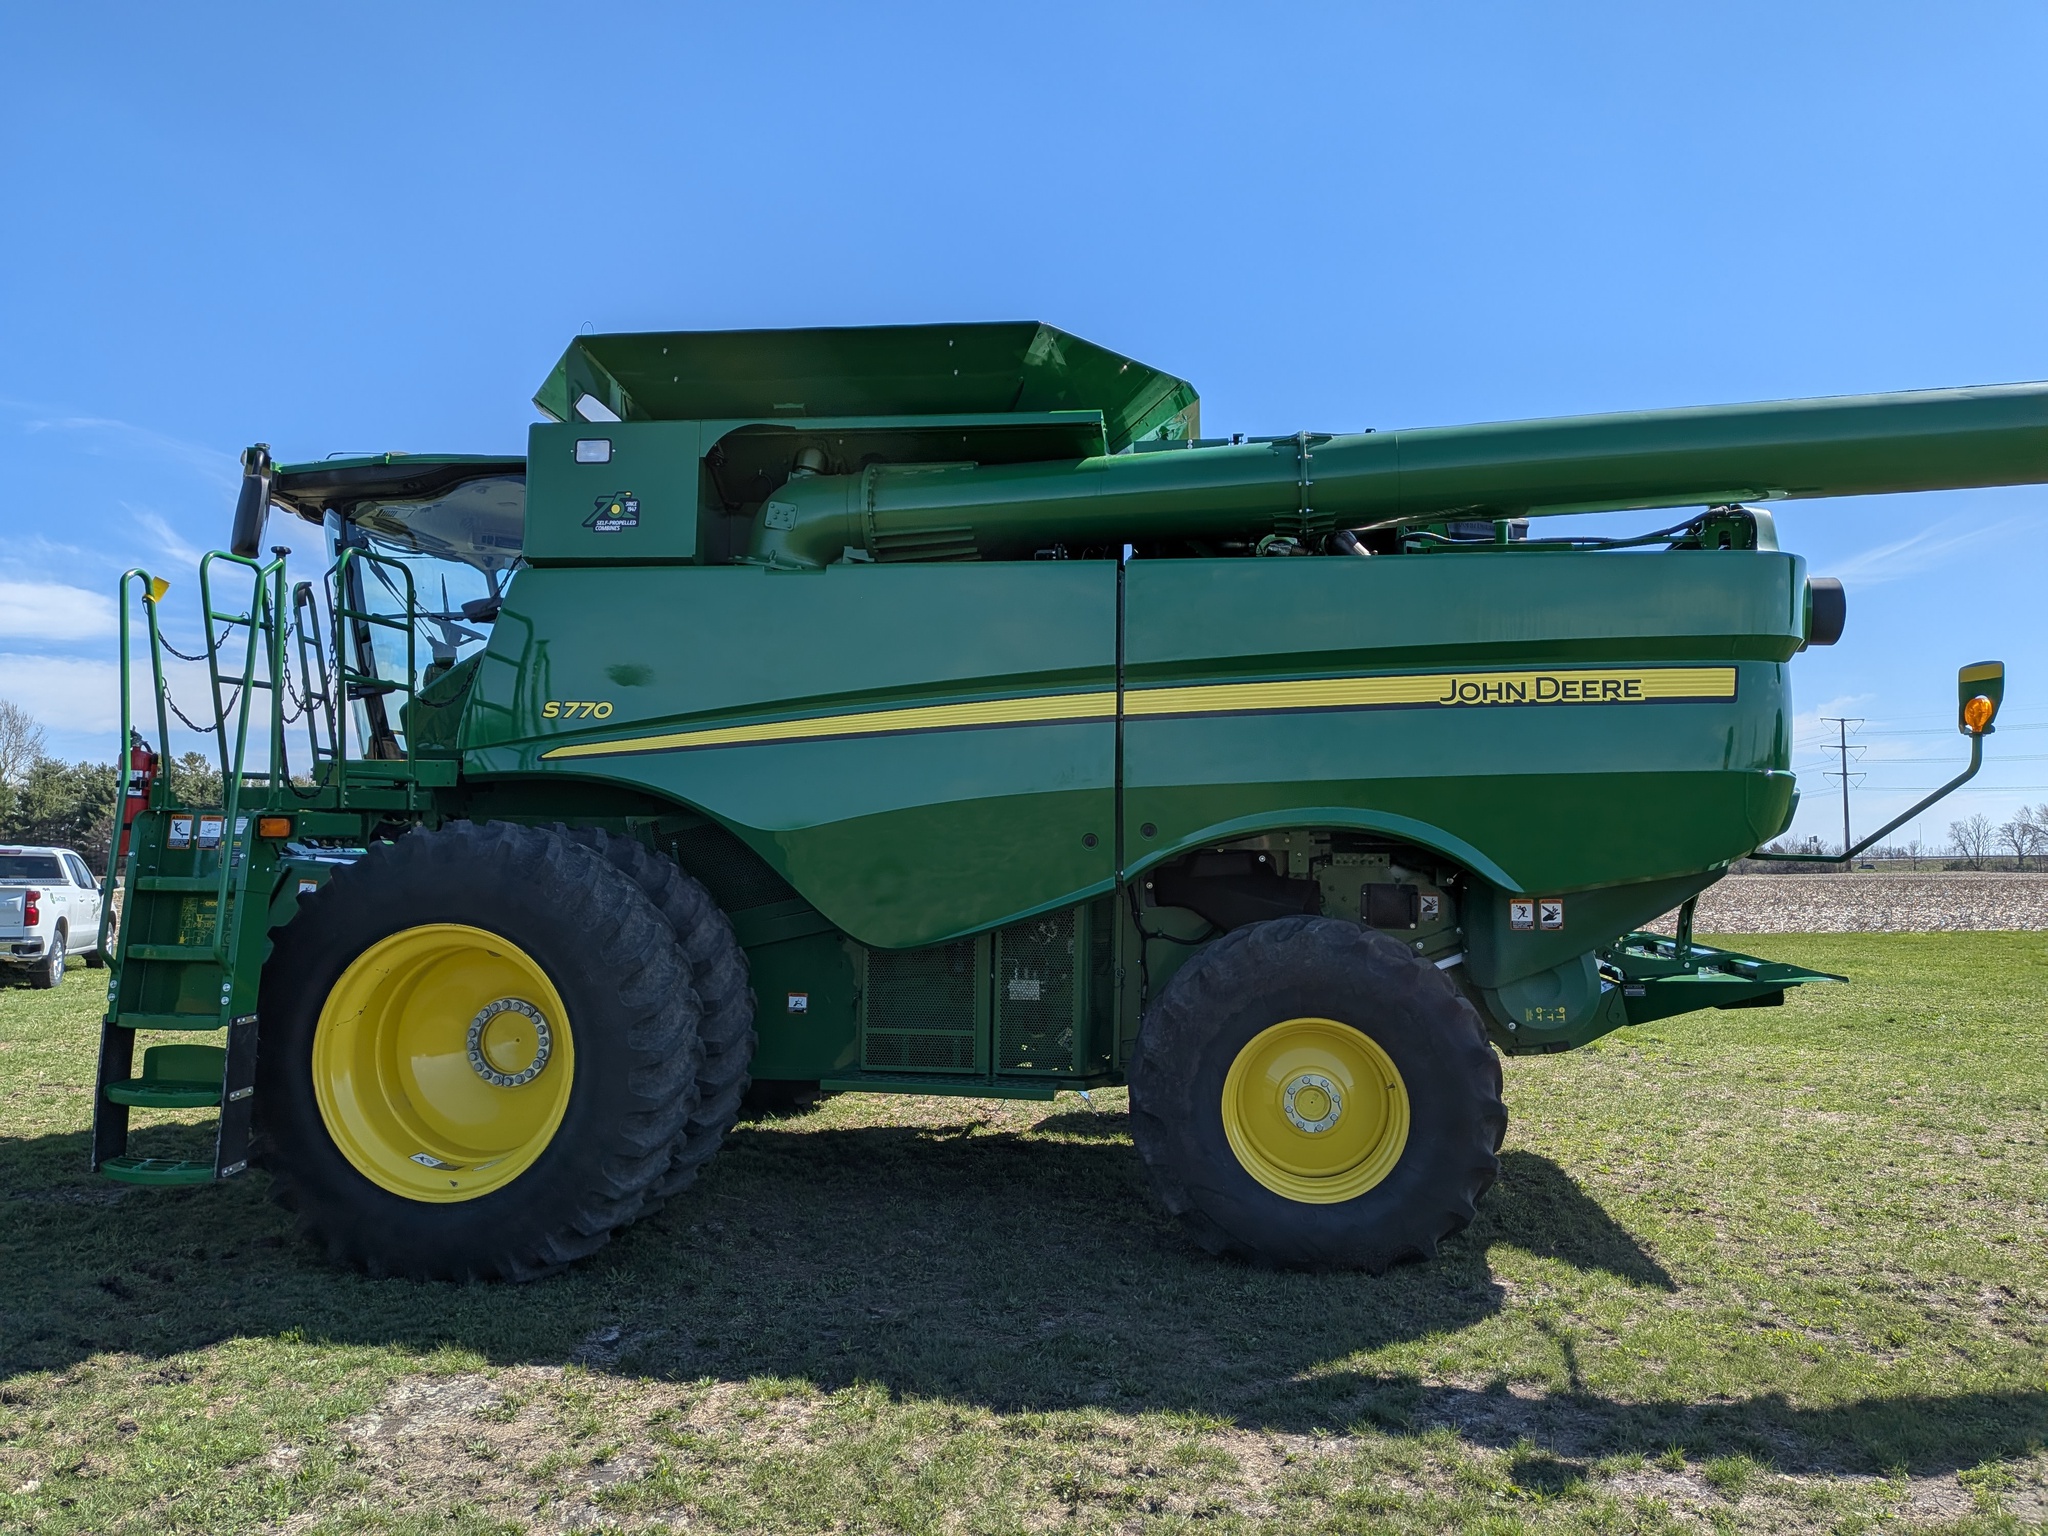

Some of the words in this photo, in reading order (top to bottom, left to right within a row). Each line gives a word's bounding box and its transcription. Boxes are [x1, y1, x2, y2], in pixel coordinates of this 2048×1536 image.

[1440, 679, 1527, 702] JOHN
[1535, 677, 1643, 701] DEERE
[541, 700, 614, 720] S770
